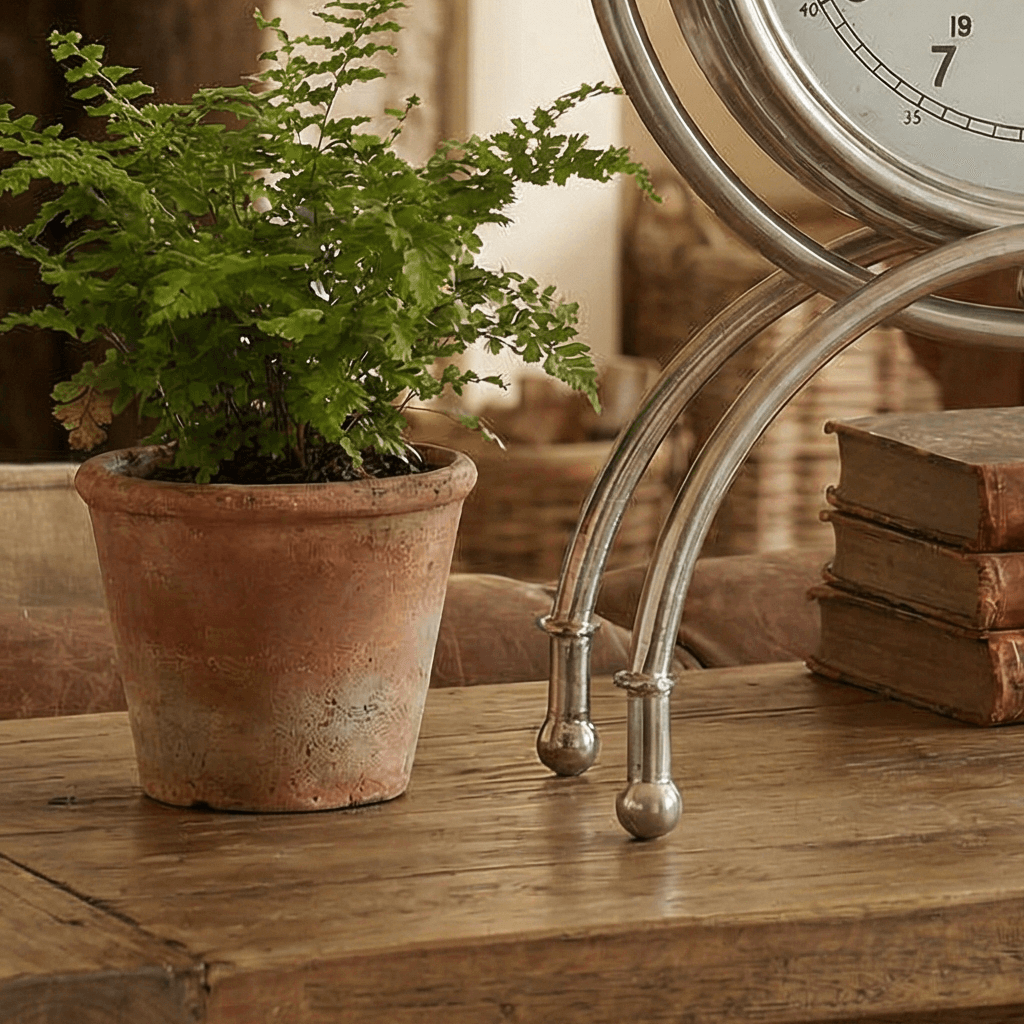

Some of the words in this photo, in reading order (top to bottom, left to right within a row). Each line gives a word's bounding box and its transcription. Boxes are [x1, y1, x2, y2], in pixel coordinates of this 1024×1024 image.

[799, 2, 818, 17] 40
[951, 15, 971, 37] 19
[931, 45, 956, 87] 7
[903, 111, 921, 125] 35
